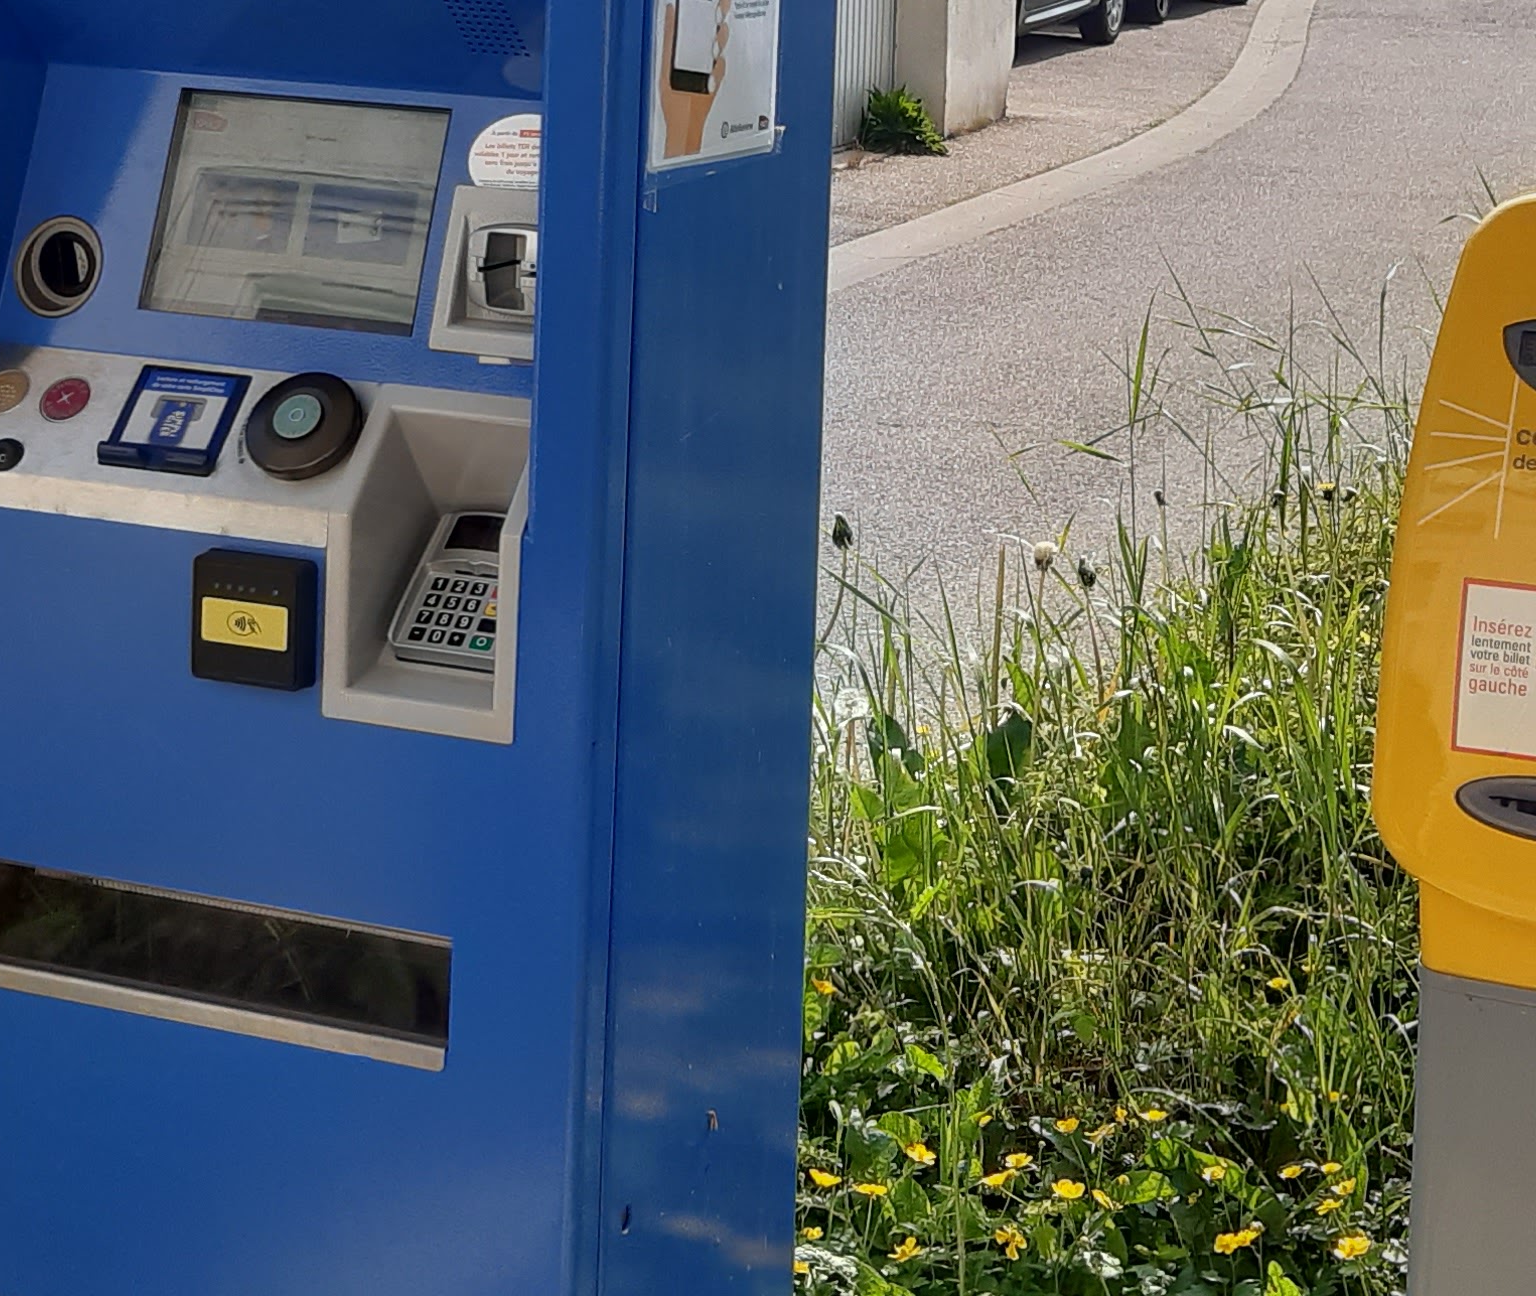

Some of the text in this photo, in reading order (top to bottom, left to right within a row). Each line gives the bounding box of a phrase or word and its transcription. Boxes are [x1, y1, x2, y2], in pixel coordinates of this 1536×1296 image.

[436, 579, 484, 594] 1 2 3
[427, 595, 476, 610] 4 5 6
[421, 611, 470, 627] 7 8 9
[1472, 615, 1532, 637] Insérez
[432, 631, 441, 641] 0
[1471, 635, 1531, 653] lentement
[1470, 649, 1531, 666] votre billet
[1469, 662, 1529, 679] sur le côté
[1468, 678, 1527, 696] gauche
